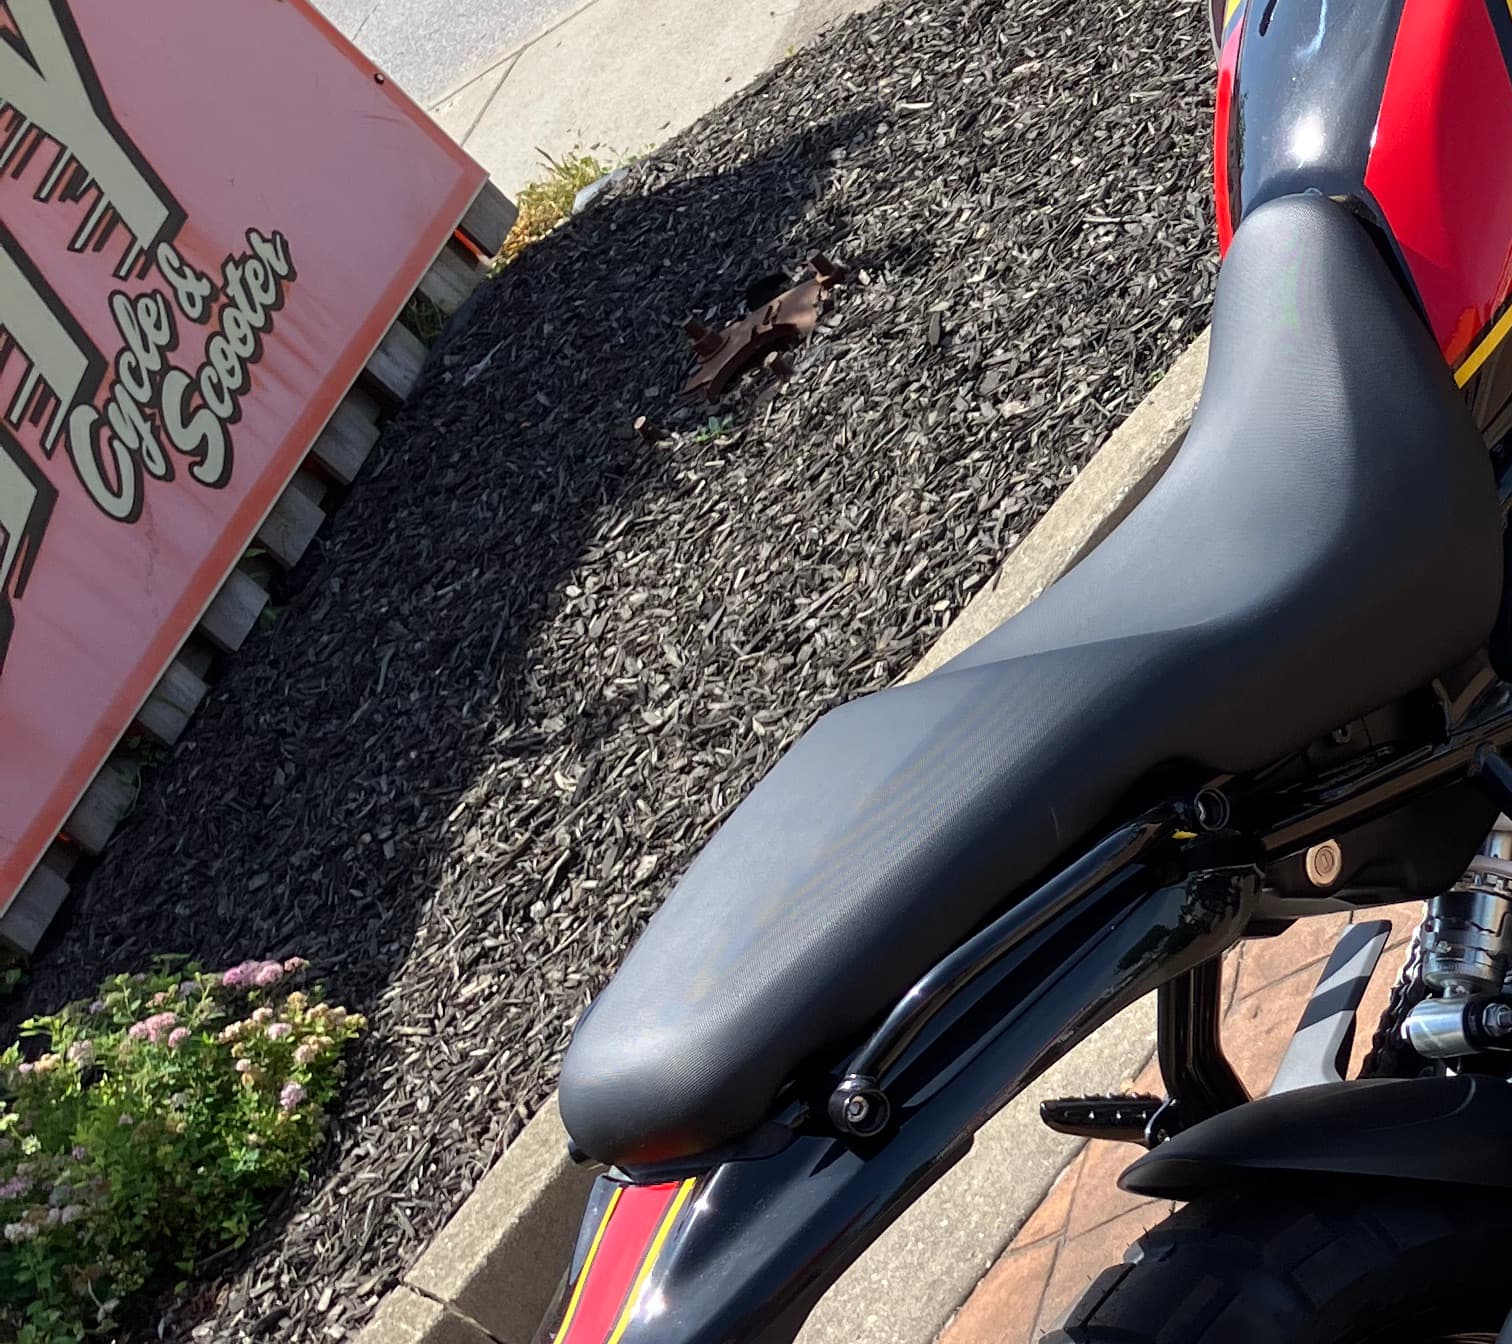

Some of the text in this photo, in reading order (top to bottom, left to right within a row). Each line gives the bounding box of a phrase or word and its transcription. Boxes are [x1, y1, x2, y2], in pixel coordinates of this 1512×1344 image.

[67, 291, 174, 520] Cycle
[156, 241, 214, 320] &
[162, 229, 291, 486] Scooter
